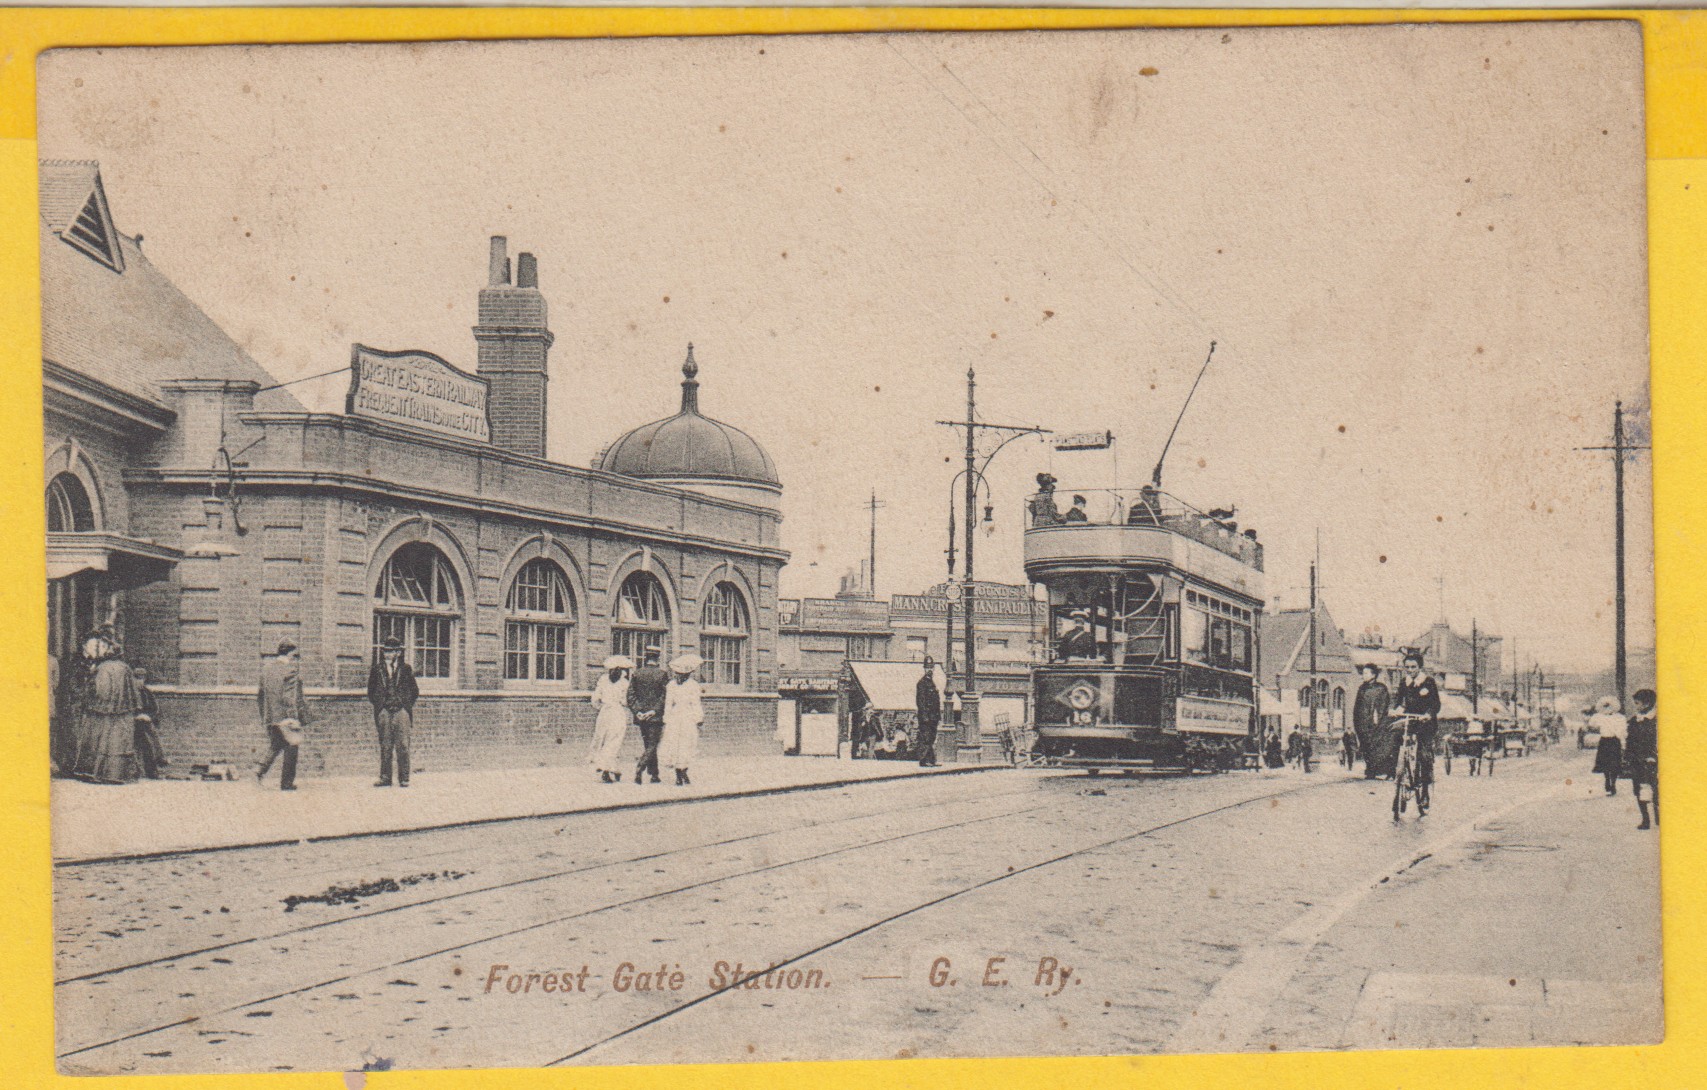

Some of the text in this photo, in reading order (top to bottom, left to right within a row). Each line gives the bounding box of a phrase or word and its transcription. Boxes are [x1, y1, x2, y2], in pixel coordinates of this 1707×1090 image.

[358, 387, 409, 417] FREQUENT
[409, 397, 442, 427] TRAINS
[360, 359, 487, 411] GREAT EASTERN RAILWAY
